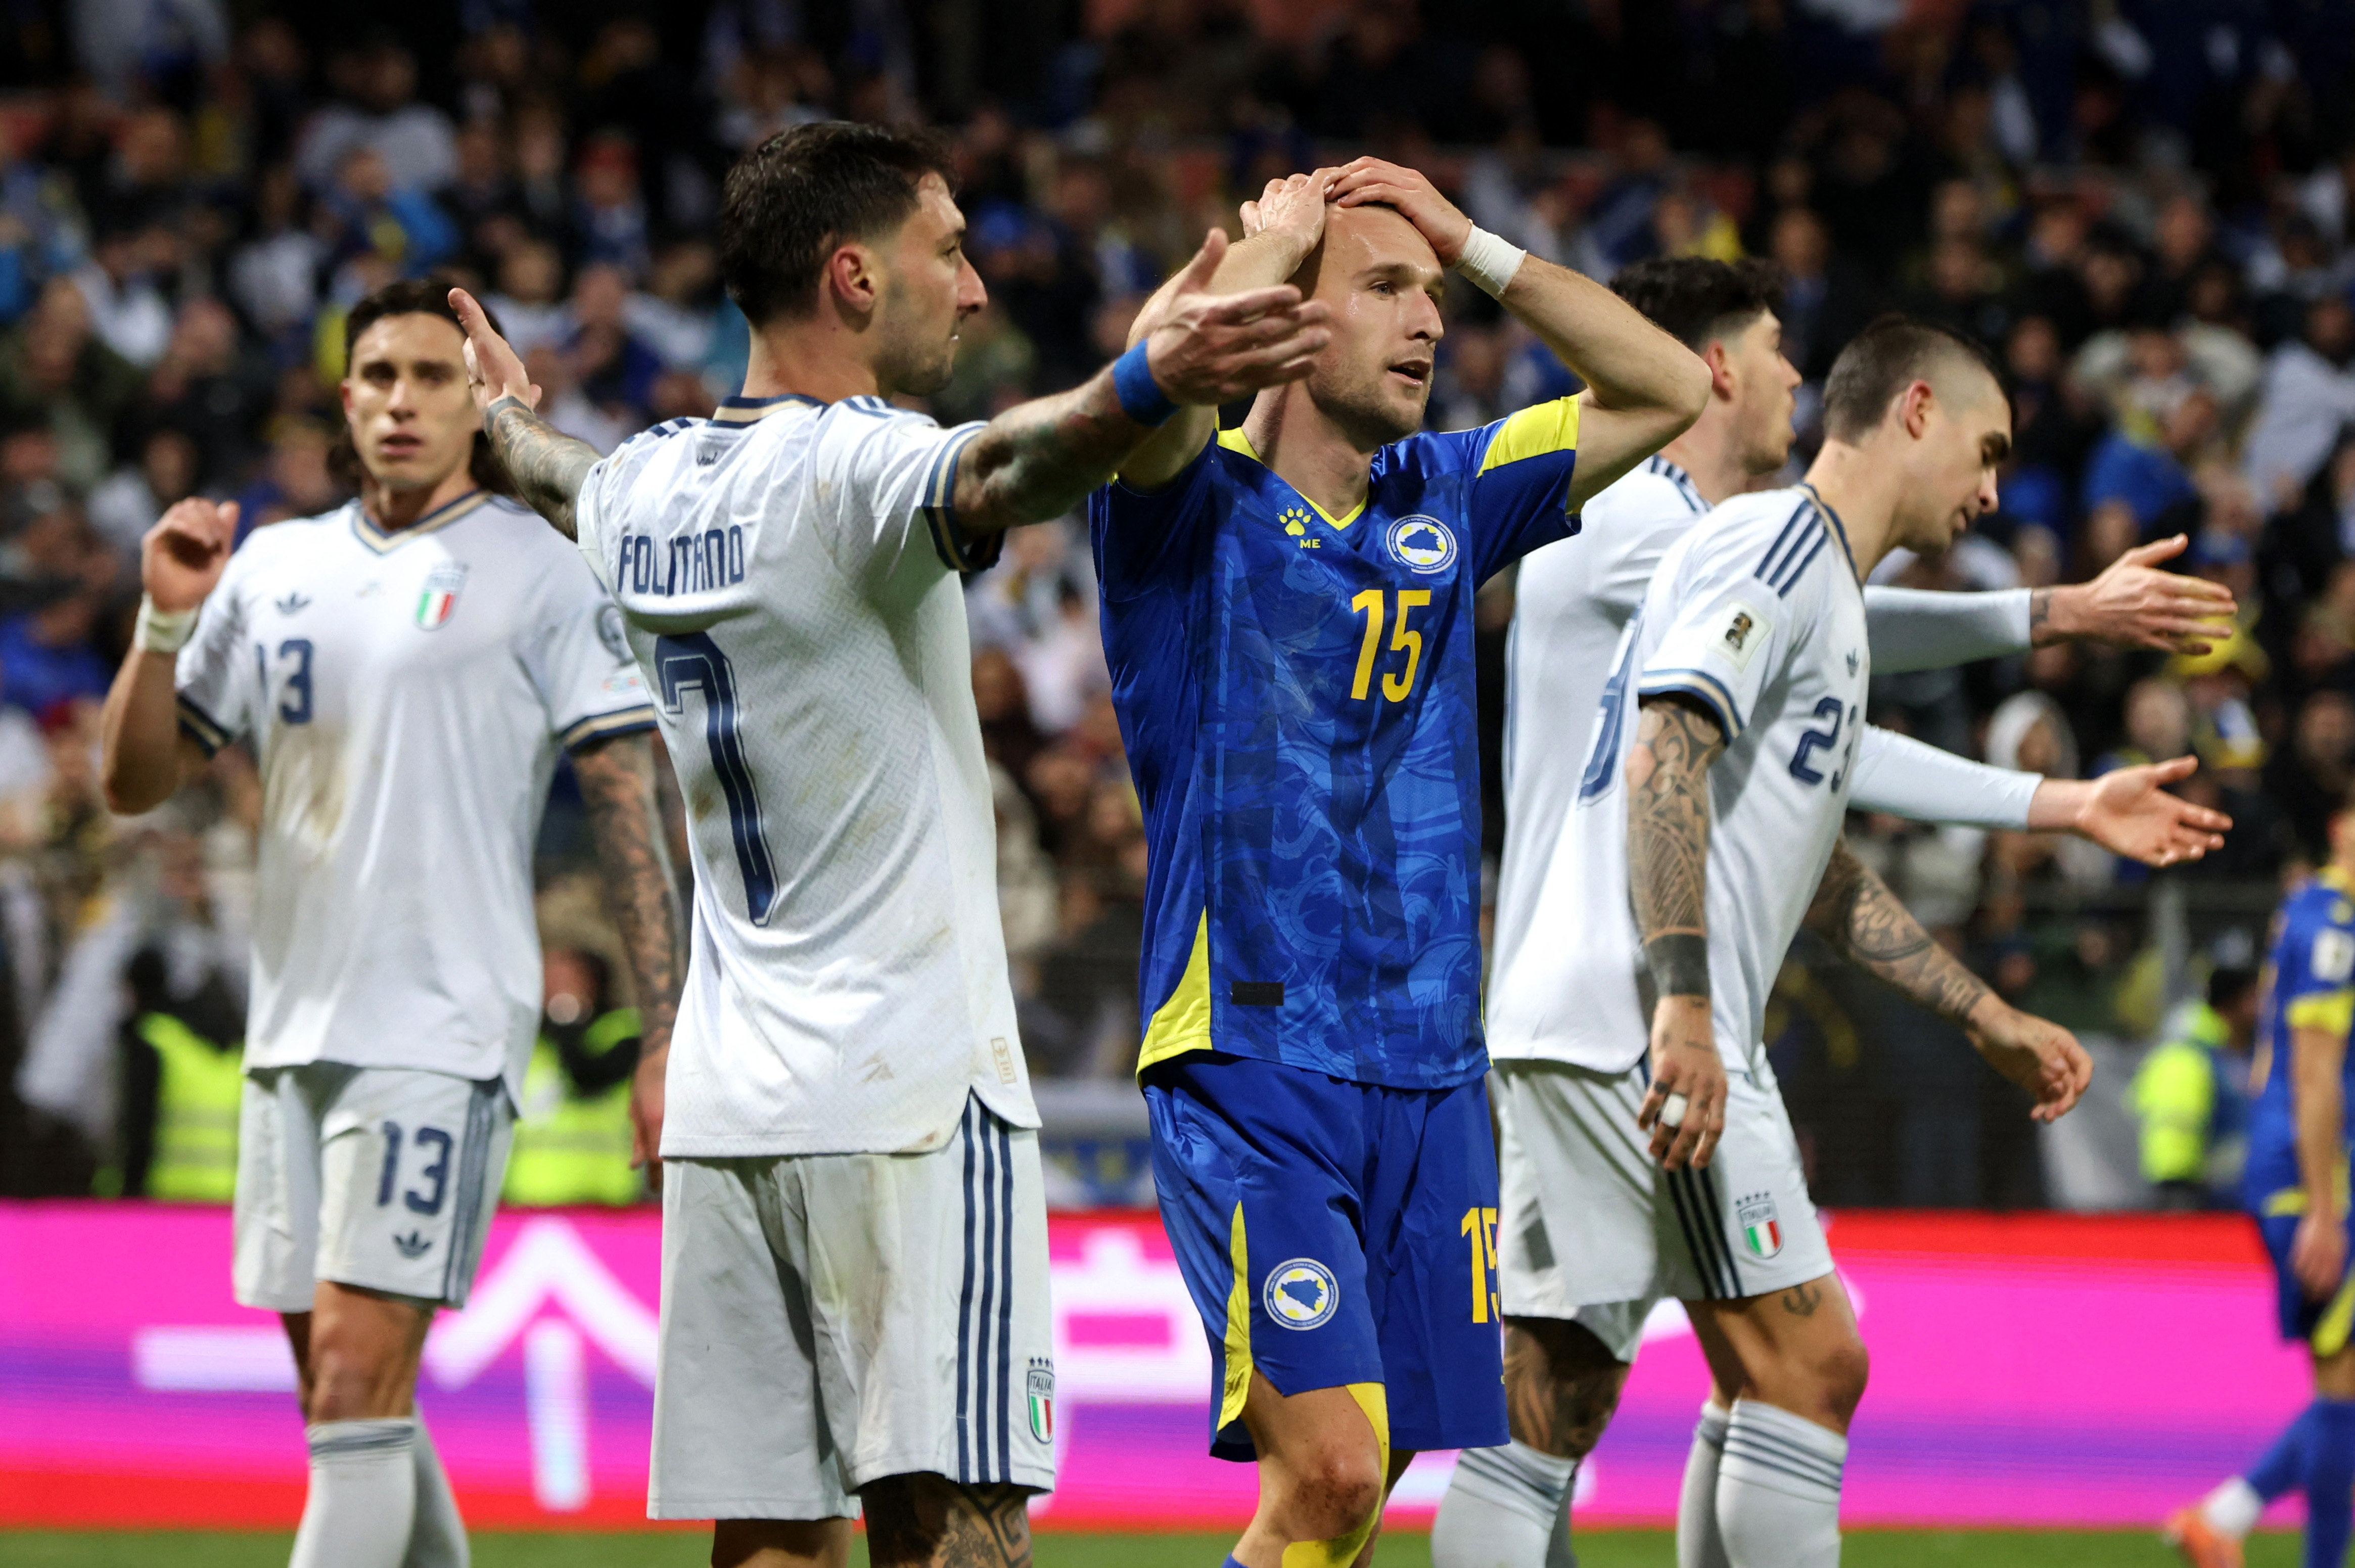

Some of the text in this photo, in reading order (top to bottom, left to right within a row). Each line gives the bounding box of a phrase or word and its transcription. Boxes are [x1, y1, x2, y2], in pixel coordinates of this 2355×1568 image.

[618, 525, 745, 596] POLITANO
[1300, 538, 1321, 548] ME
[254, 638, 314, 724] 13
[1351, 589, 1431, 703] 15
[655, 630, 779, 927] 7
[377, 1120, 453, 1216] 13
[1030, 1375, 1052, 1393] ITALIA
